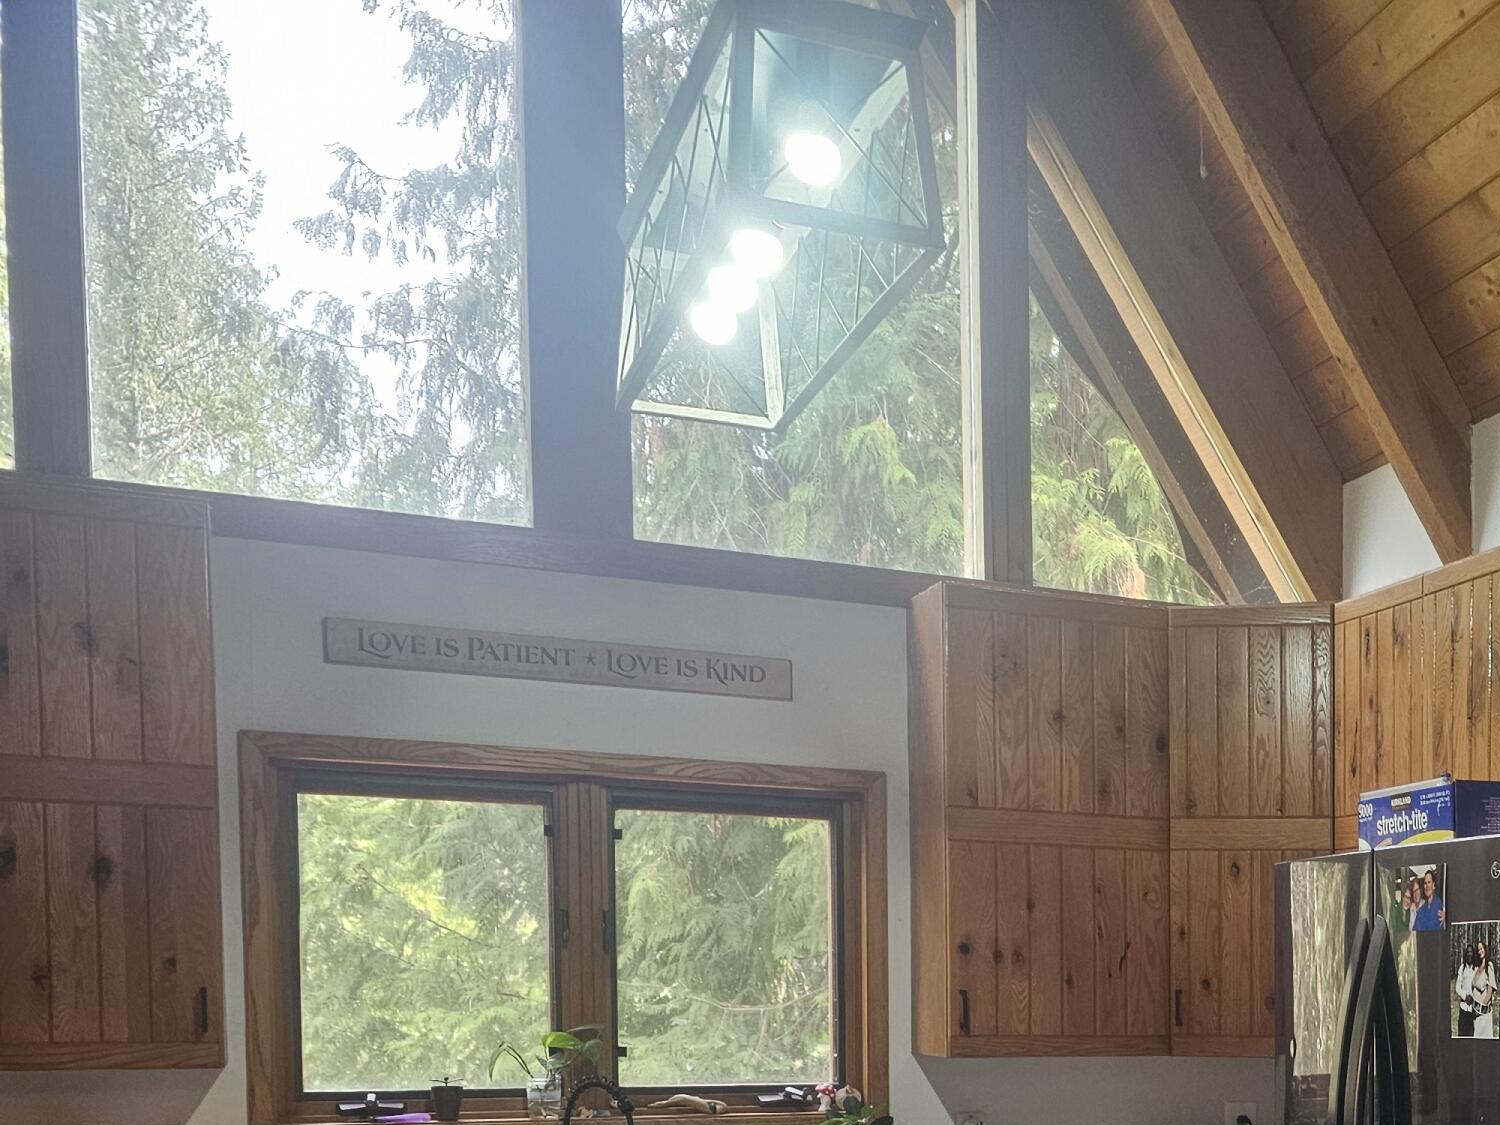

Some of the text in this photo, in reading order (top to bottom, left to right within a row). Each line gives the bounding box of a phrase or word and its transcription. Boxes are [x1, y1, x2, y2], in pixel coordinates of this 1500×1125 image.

[356, 626, 767, 687] LOVE IS PATIENT LOVE IS KIND
[1377, 808, 1428, 836] stretch-tite
